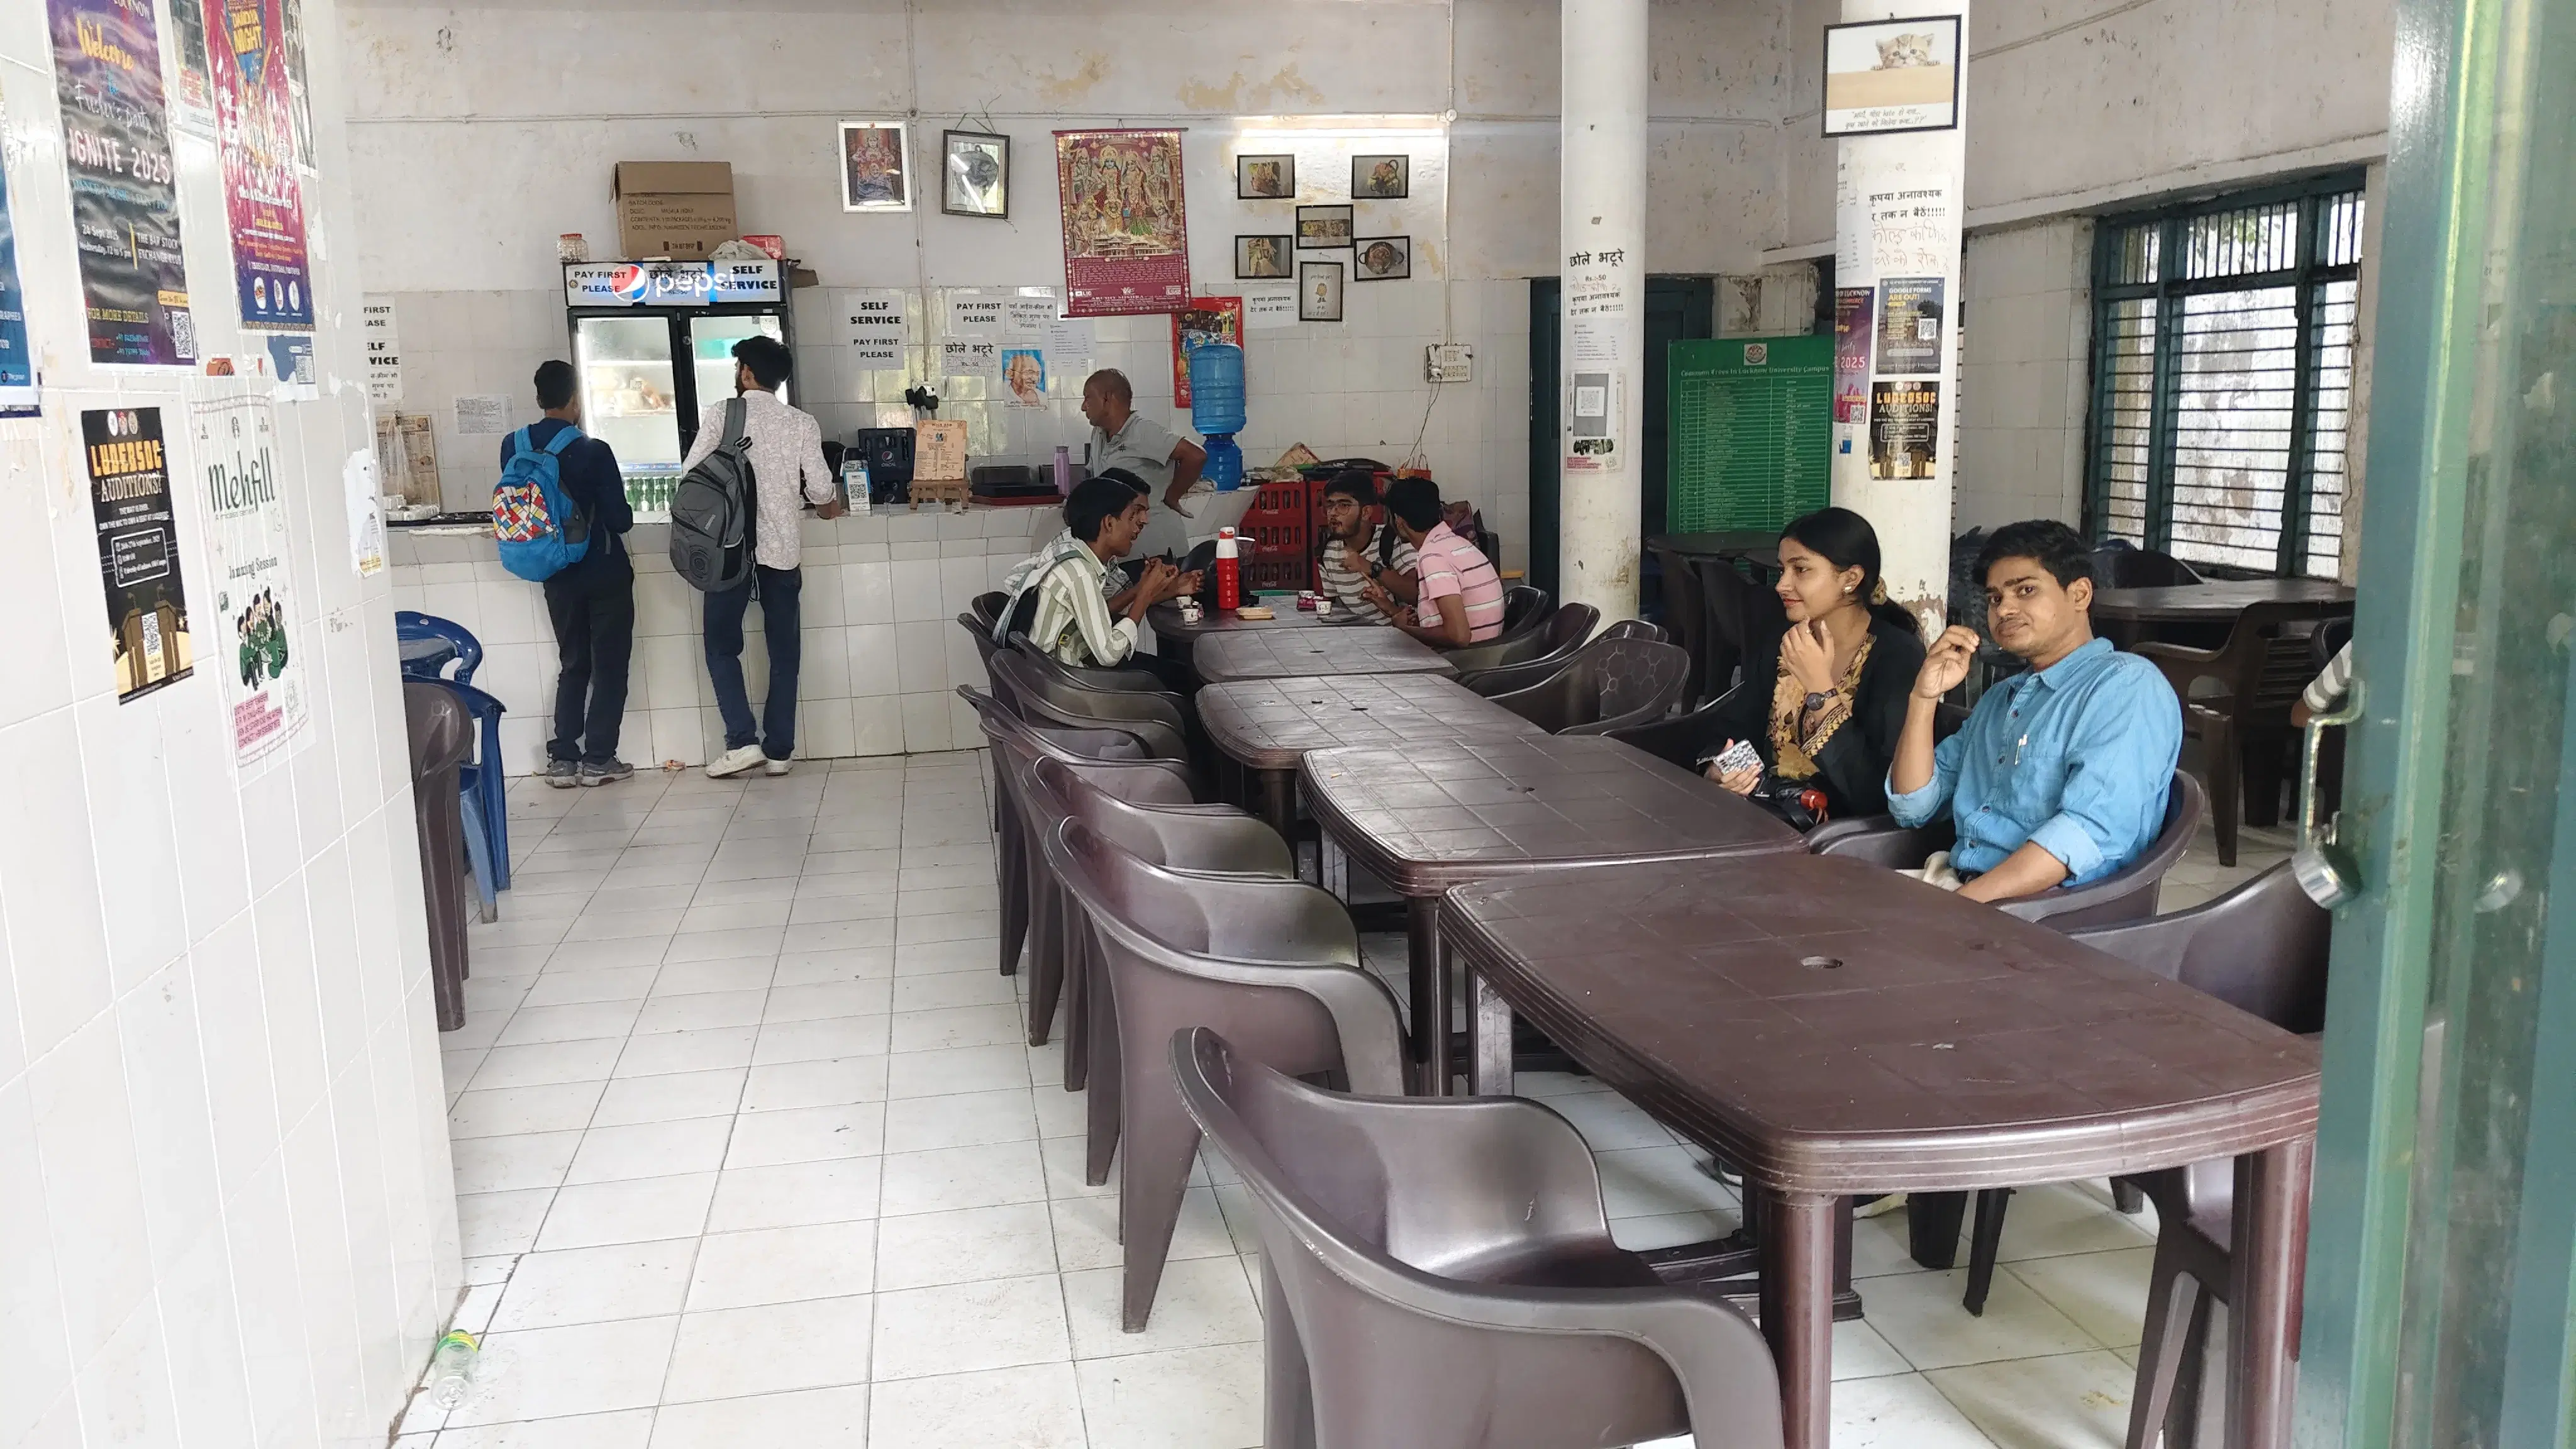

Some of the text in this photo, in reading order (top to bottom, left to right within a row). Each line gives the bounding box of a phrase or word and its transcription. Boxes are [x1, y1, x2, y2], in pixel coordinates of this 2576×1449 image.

[234, 26, 262, 53] NIGHT
[69, 128, 170, 184] IGNITE 2025
[1868, 189, 1943, 207] कृपया अनावश्यक
[1880, 210, 1897, 221] तक
[1900, 209, 1909, 218] न
[1569, 248, 1625, 267] छोले भटूरे
[732, 265, 763, 275] SELF
[655, 268, 736, 297] pepsi
[720, 280, 777, 290] SERVICE
[860, 302, 889, 310] SELF
[1572, 291, 1621, 306] कृपया अनावश्यक
[850, 316, 901, 325] SERVICE
[945, 341, 994, 357] छोले भटूरे
[1768, 366, 1802, 374] University
[1802, 365, 1830, 374] Campus
[1841, 355, 1866, 369] 2025
[1879, 403, 1933, 414] AUDITIONS!
[101, 472, 162, 502] AUDITIONS!
[208, 446, 275, 513] Mehfill
[256, 554, 277, 572] Session
